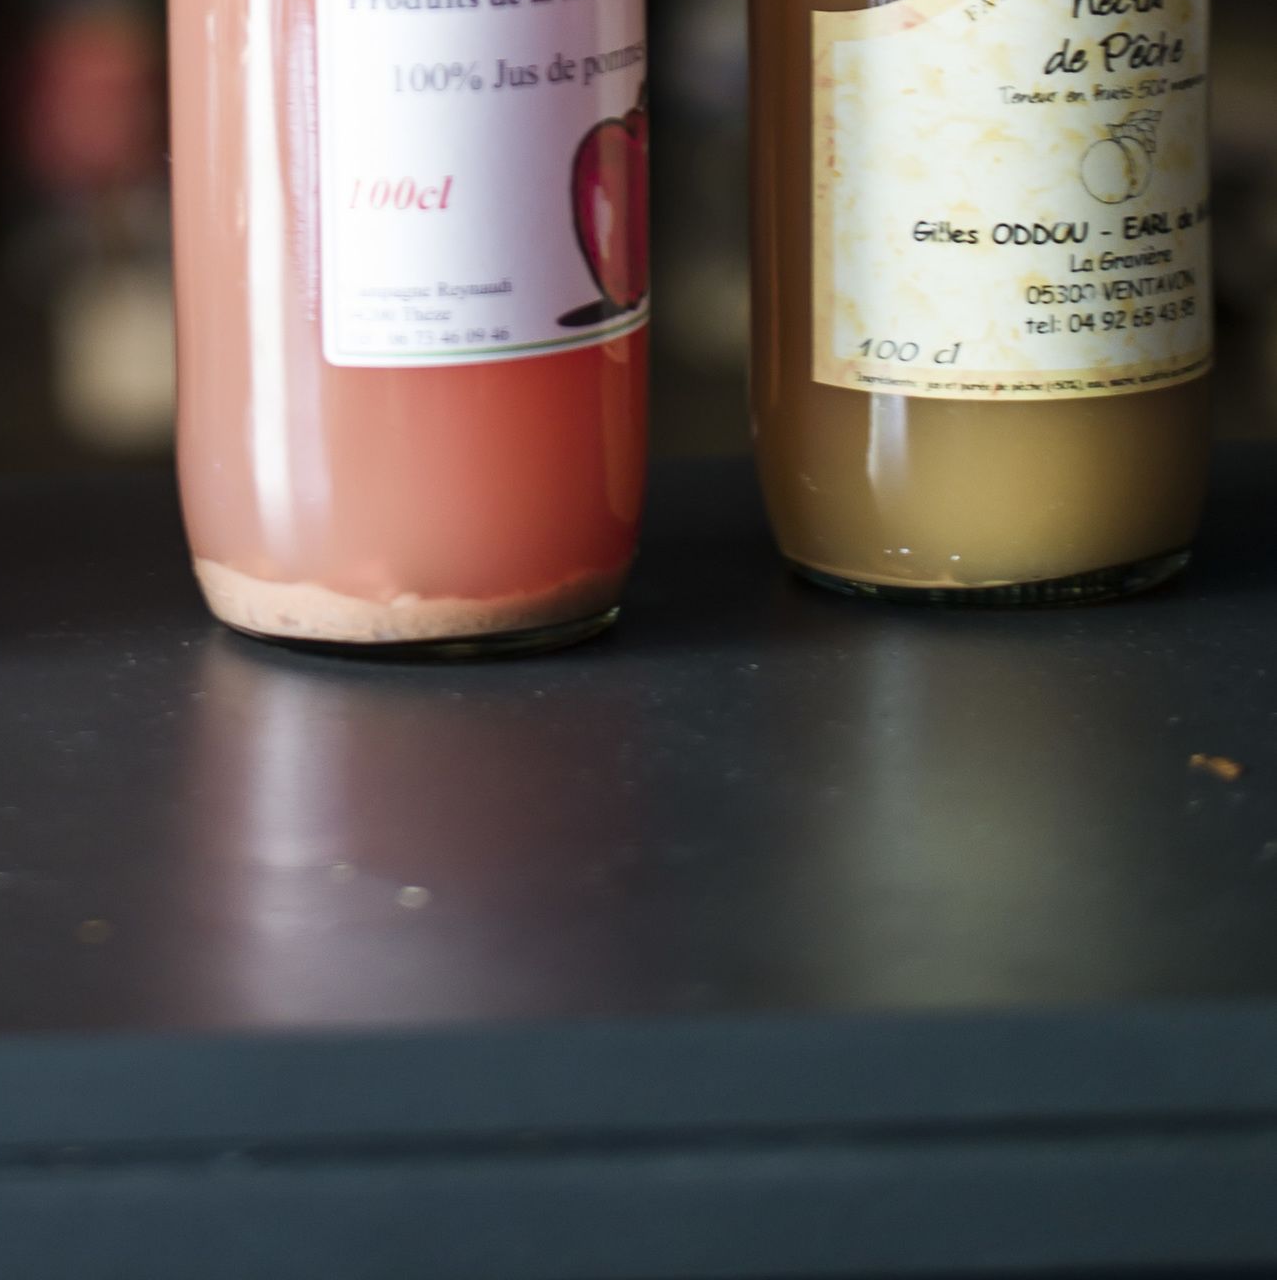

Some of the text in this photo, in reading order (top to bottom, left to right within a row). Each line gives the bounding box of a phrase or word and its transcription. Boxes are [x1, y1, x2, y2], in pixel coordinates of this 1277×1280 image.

[1043, 31, 1184, 76] de Pêche
[393, 60, 484, 93] 100%
[492, 57, 539, 89] Jus
[547, 51, 576, 83] de
[348, 175, 454, 211] 100cl
[912, 220, 979, 245] Gilles
[991, 220, 1090, 246] ODDOU
[1123, 210, 1172, 240] EARL
[1070, 253, 1093, 273] La
[1068, 312, 1096, 334] 04
[1101, 309, 1127, 332] 92
[858, 338, 963, 365] 100 cl
